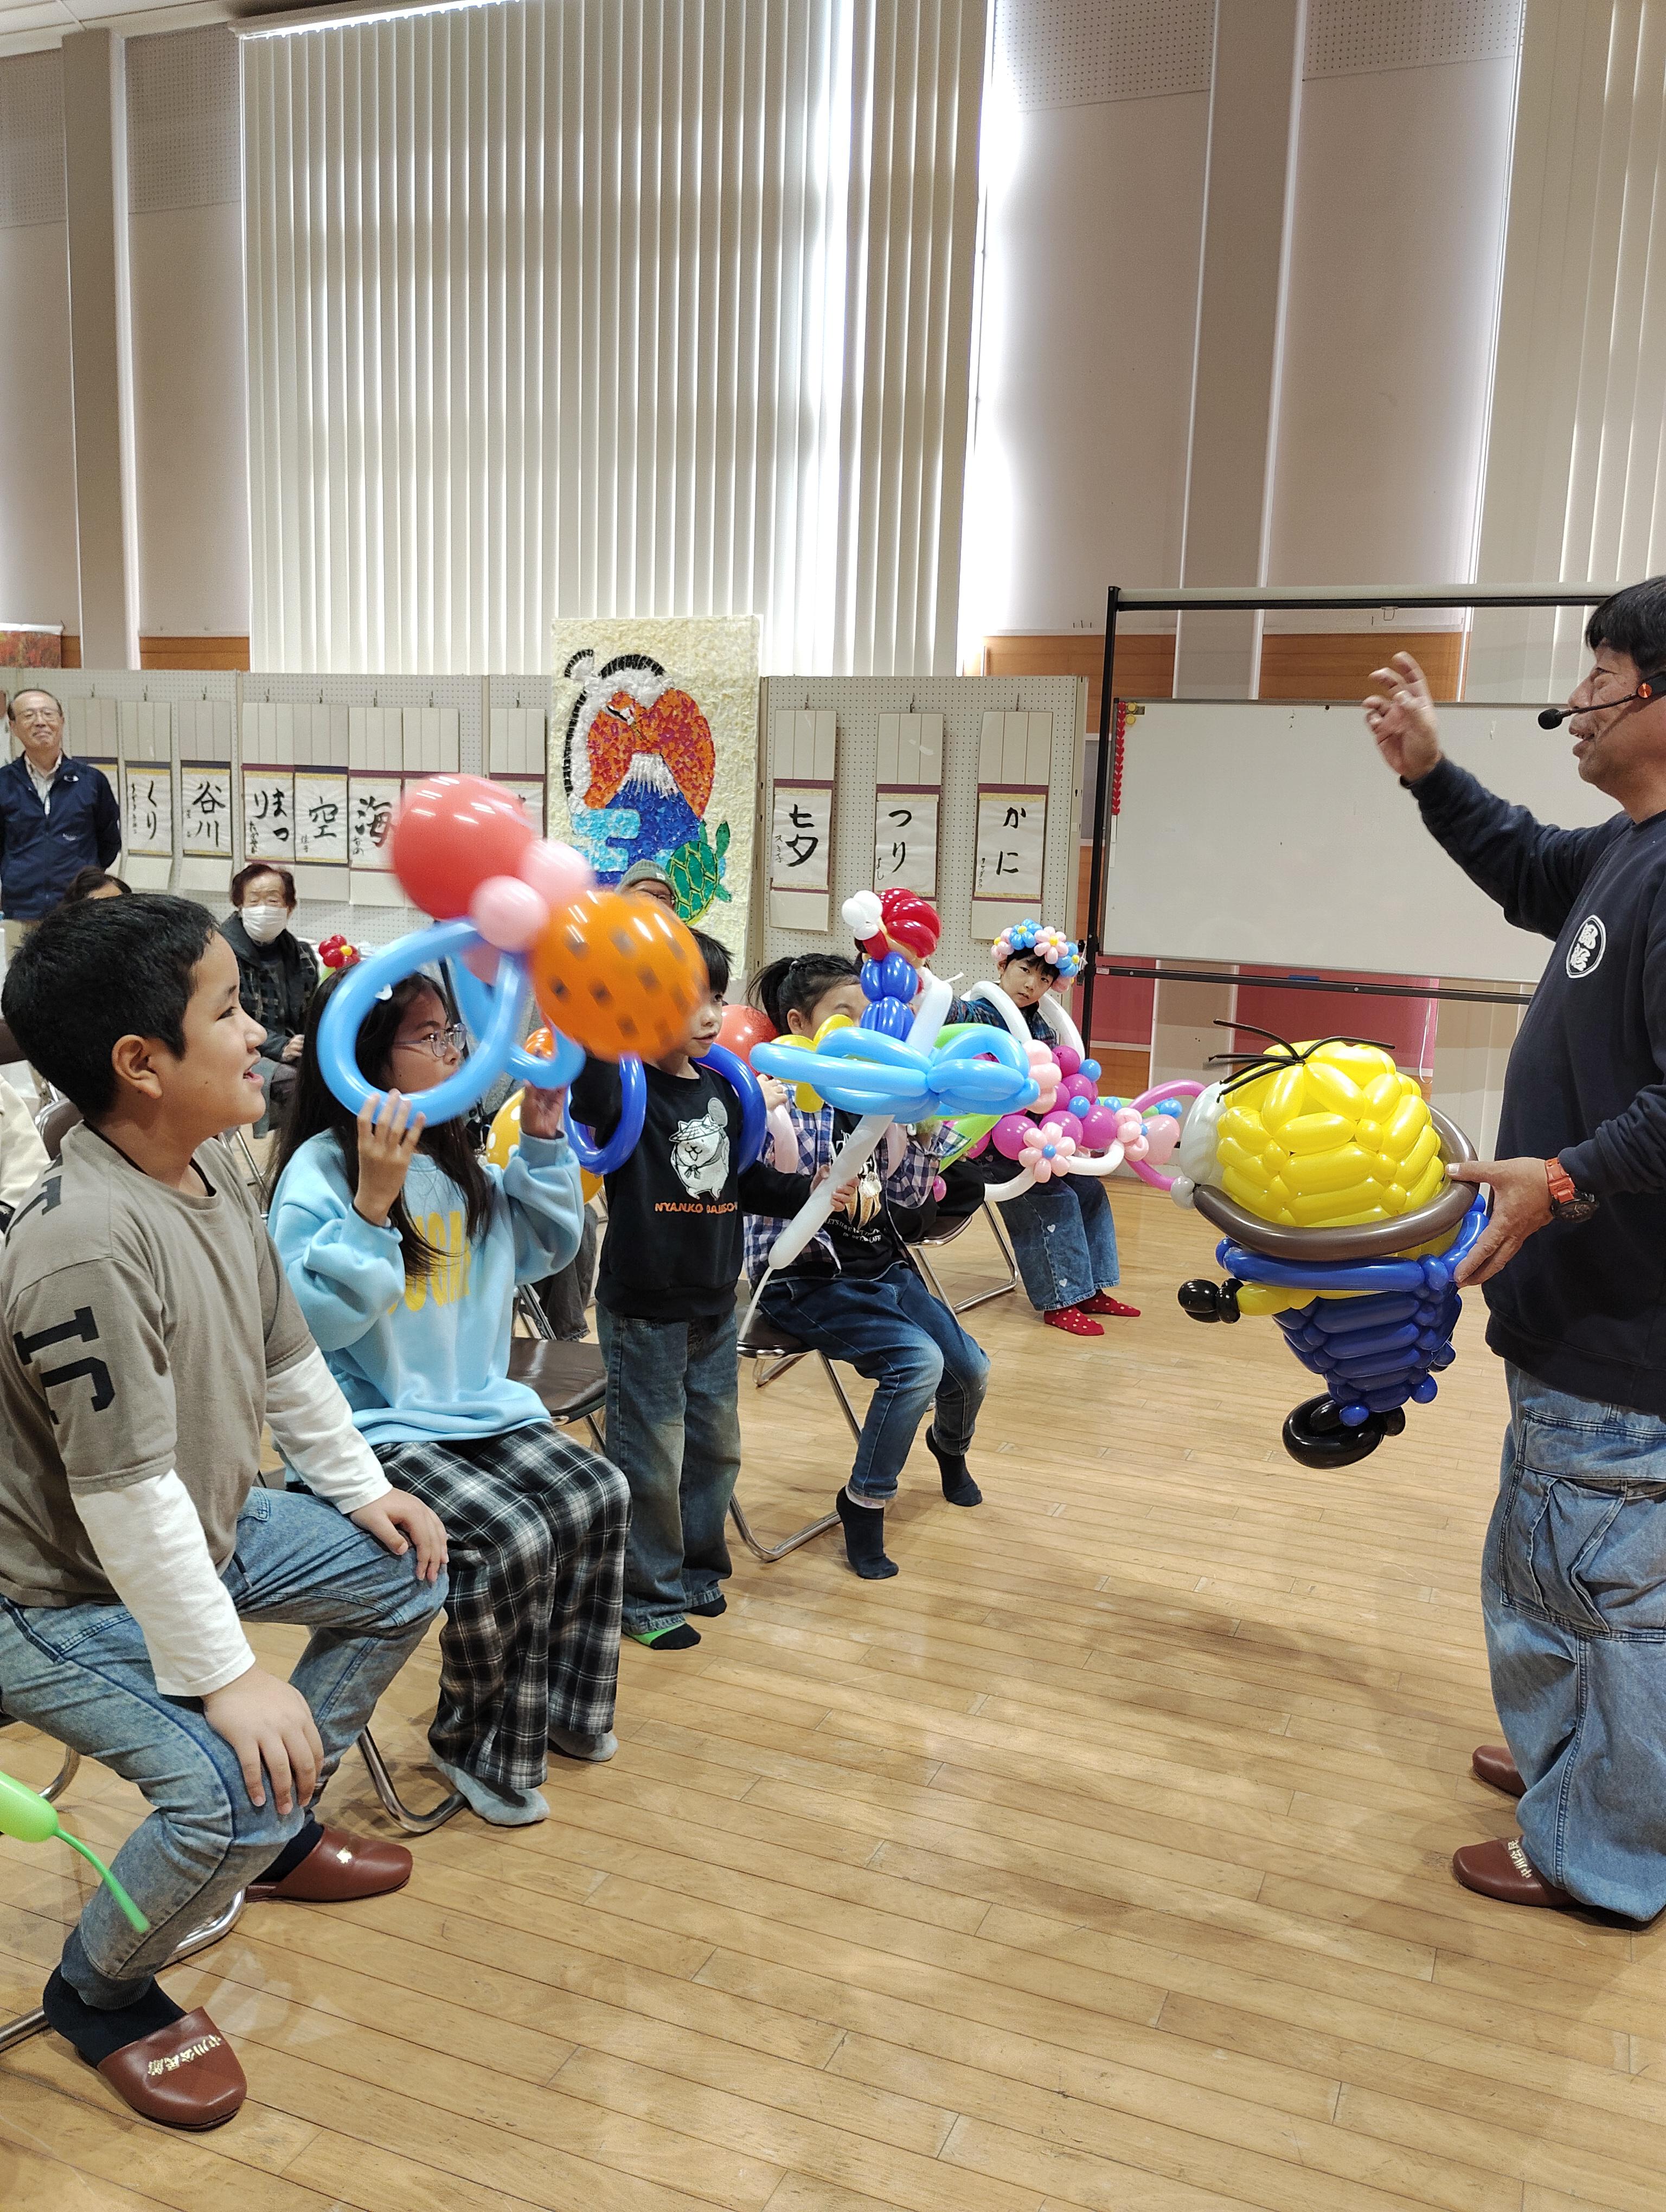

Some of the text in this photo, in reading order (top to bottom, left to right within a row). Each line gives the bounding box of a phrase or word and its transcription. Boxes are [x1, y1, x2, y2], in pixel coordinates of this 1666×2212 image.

[146, 780, 157, 840] くり
[191, 781, 226, 847] 谷川
[309, 795, 338, 839] 空
[354, 795, 394, 848] 海
[785, 803, 819, 867] 七夕
[888, 809, 912, 873] つり
[996, 807, 1027, 876] かに
[655, 1202, 703, 1213] NYANKO
[1508, 1836, 1533, 1879] 中川公民
